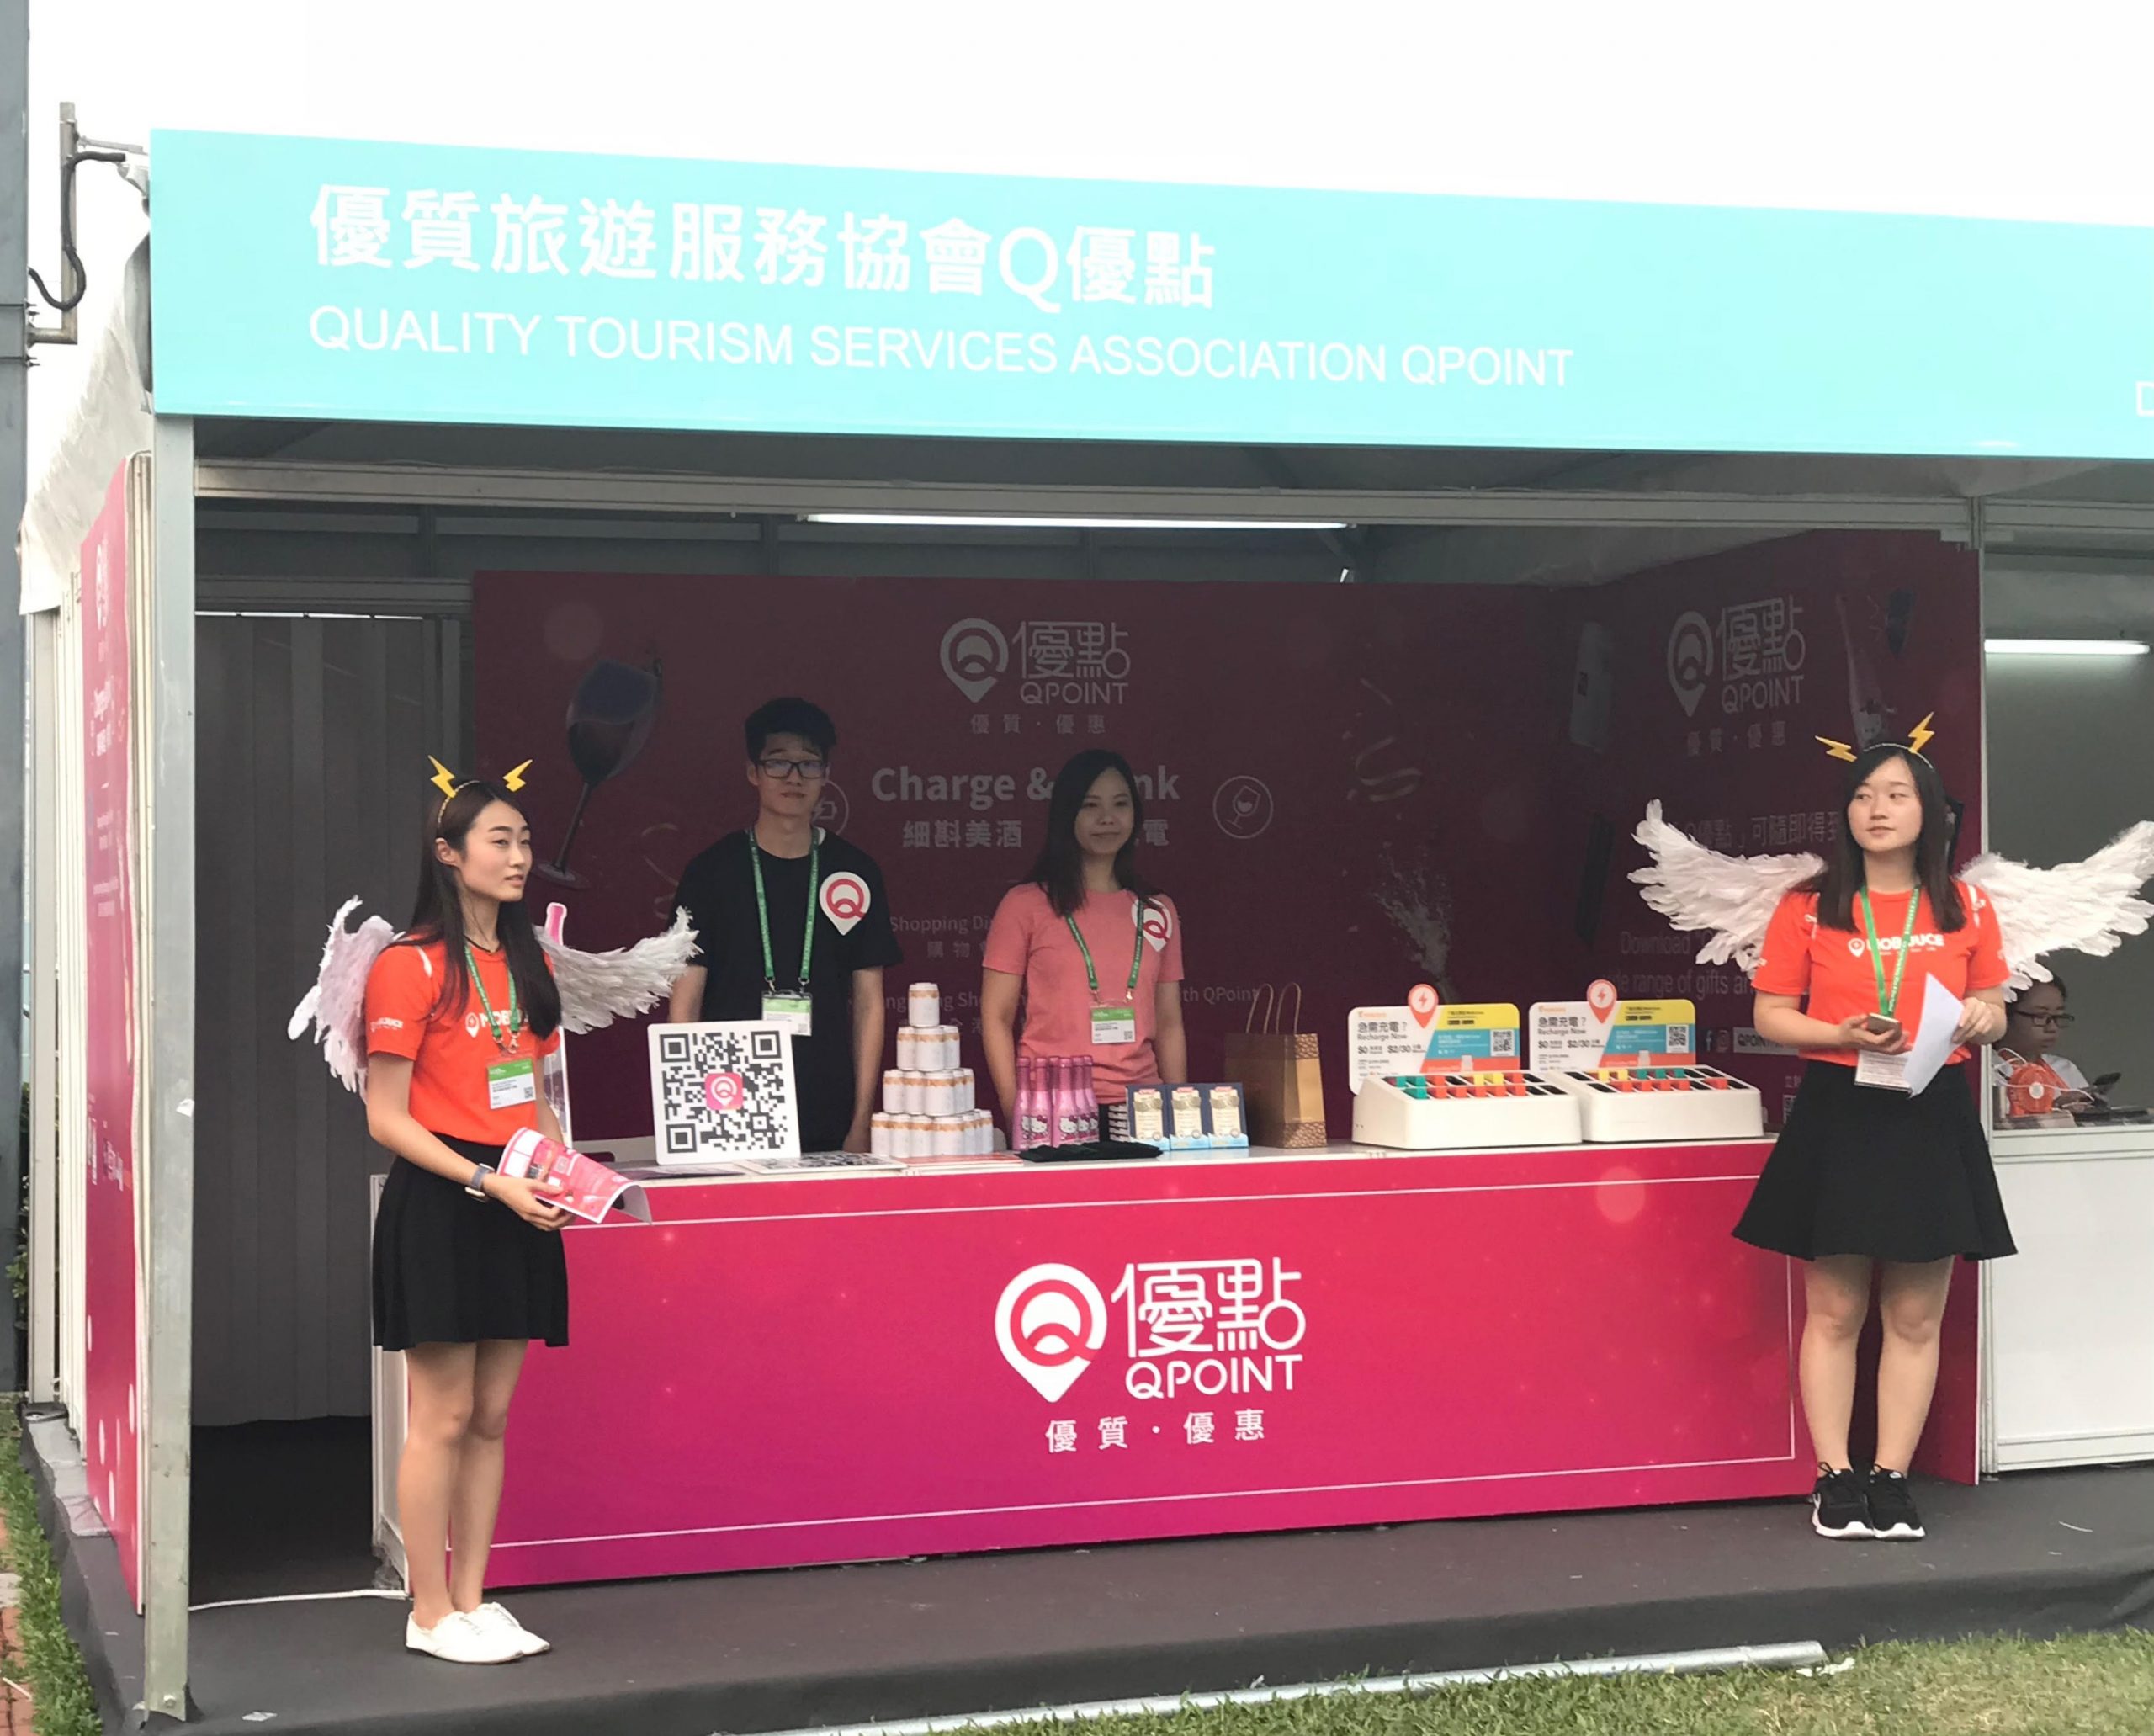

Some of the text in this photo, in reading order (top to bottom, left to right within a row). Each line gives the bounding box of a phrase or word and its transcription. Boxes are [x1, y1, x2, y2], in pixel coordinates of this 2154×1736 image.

[310, 183, 1216, 313] 優質旅遊服務協會Q優點
[309, 305, 1573, 387] QUALITY TOURISM SERVICES ASSOCIATION QPOINT
[1012, 620, 1131, 680] 優點
[1021, 682, 1129, 705] QPOINT
[1722, 674, 1805, 714] QPOINT
[872, 766, 1016, 810] Charge
[1027, 767, 1053, 800] &
[903, 819, 1023, 848] 細斟美酒
[889, 915, 968, 934] Shopping
[1621, 930, 1691, 955] Download
[1632, 973, 1674, 998] range
[1677, 969, 1693, 994] of
[1695, 968, 1729, 1001] gifts
[1356, 1033, 1390, 1043] Recharge
[1537, 1028, 1569, 1037] Recharge
[1111, 1256, 1307, 1359] 優點
[1125, 1354, 1304, 1400] QPOINT
